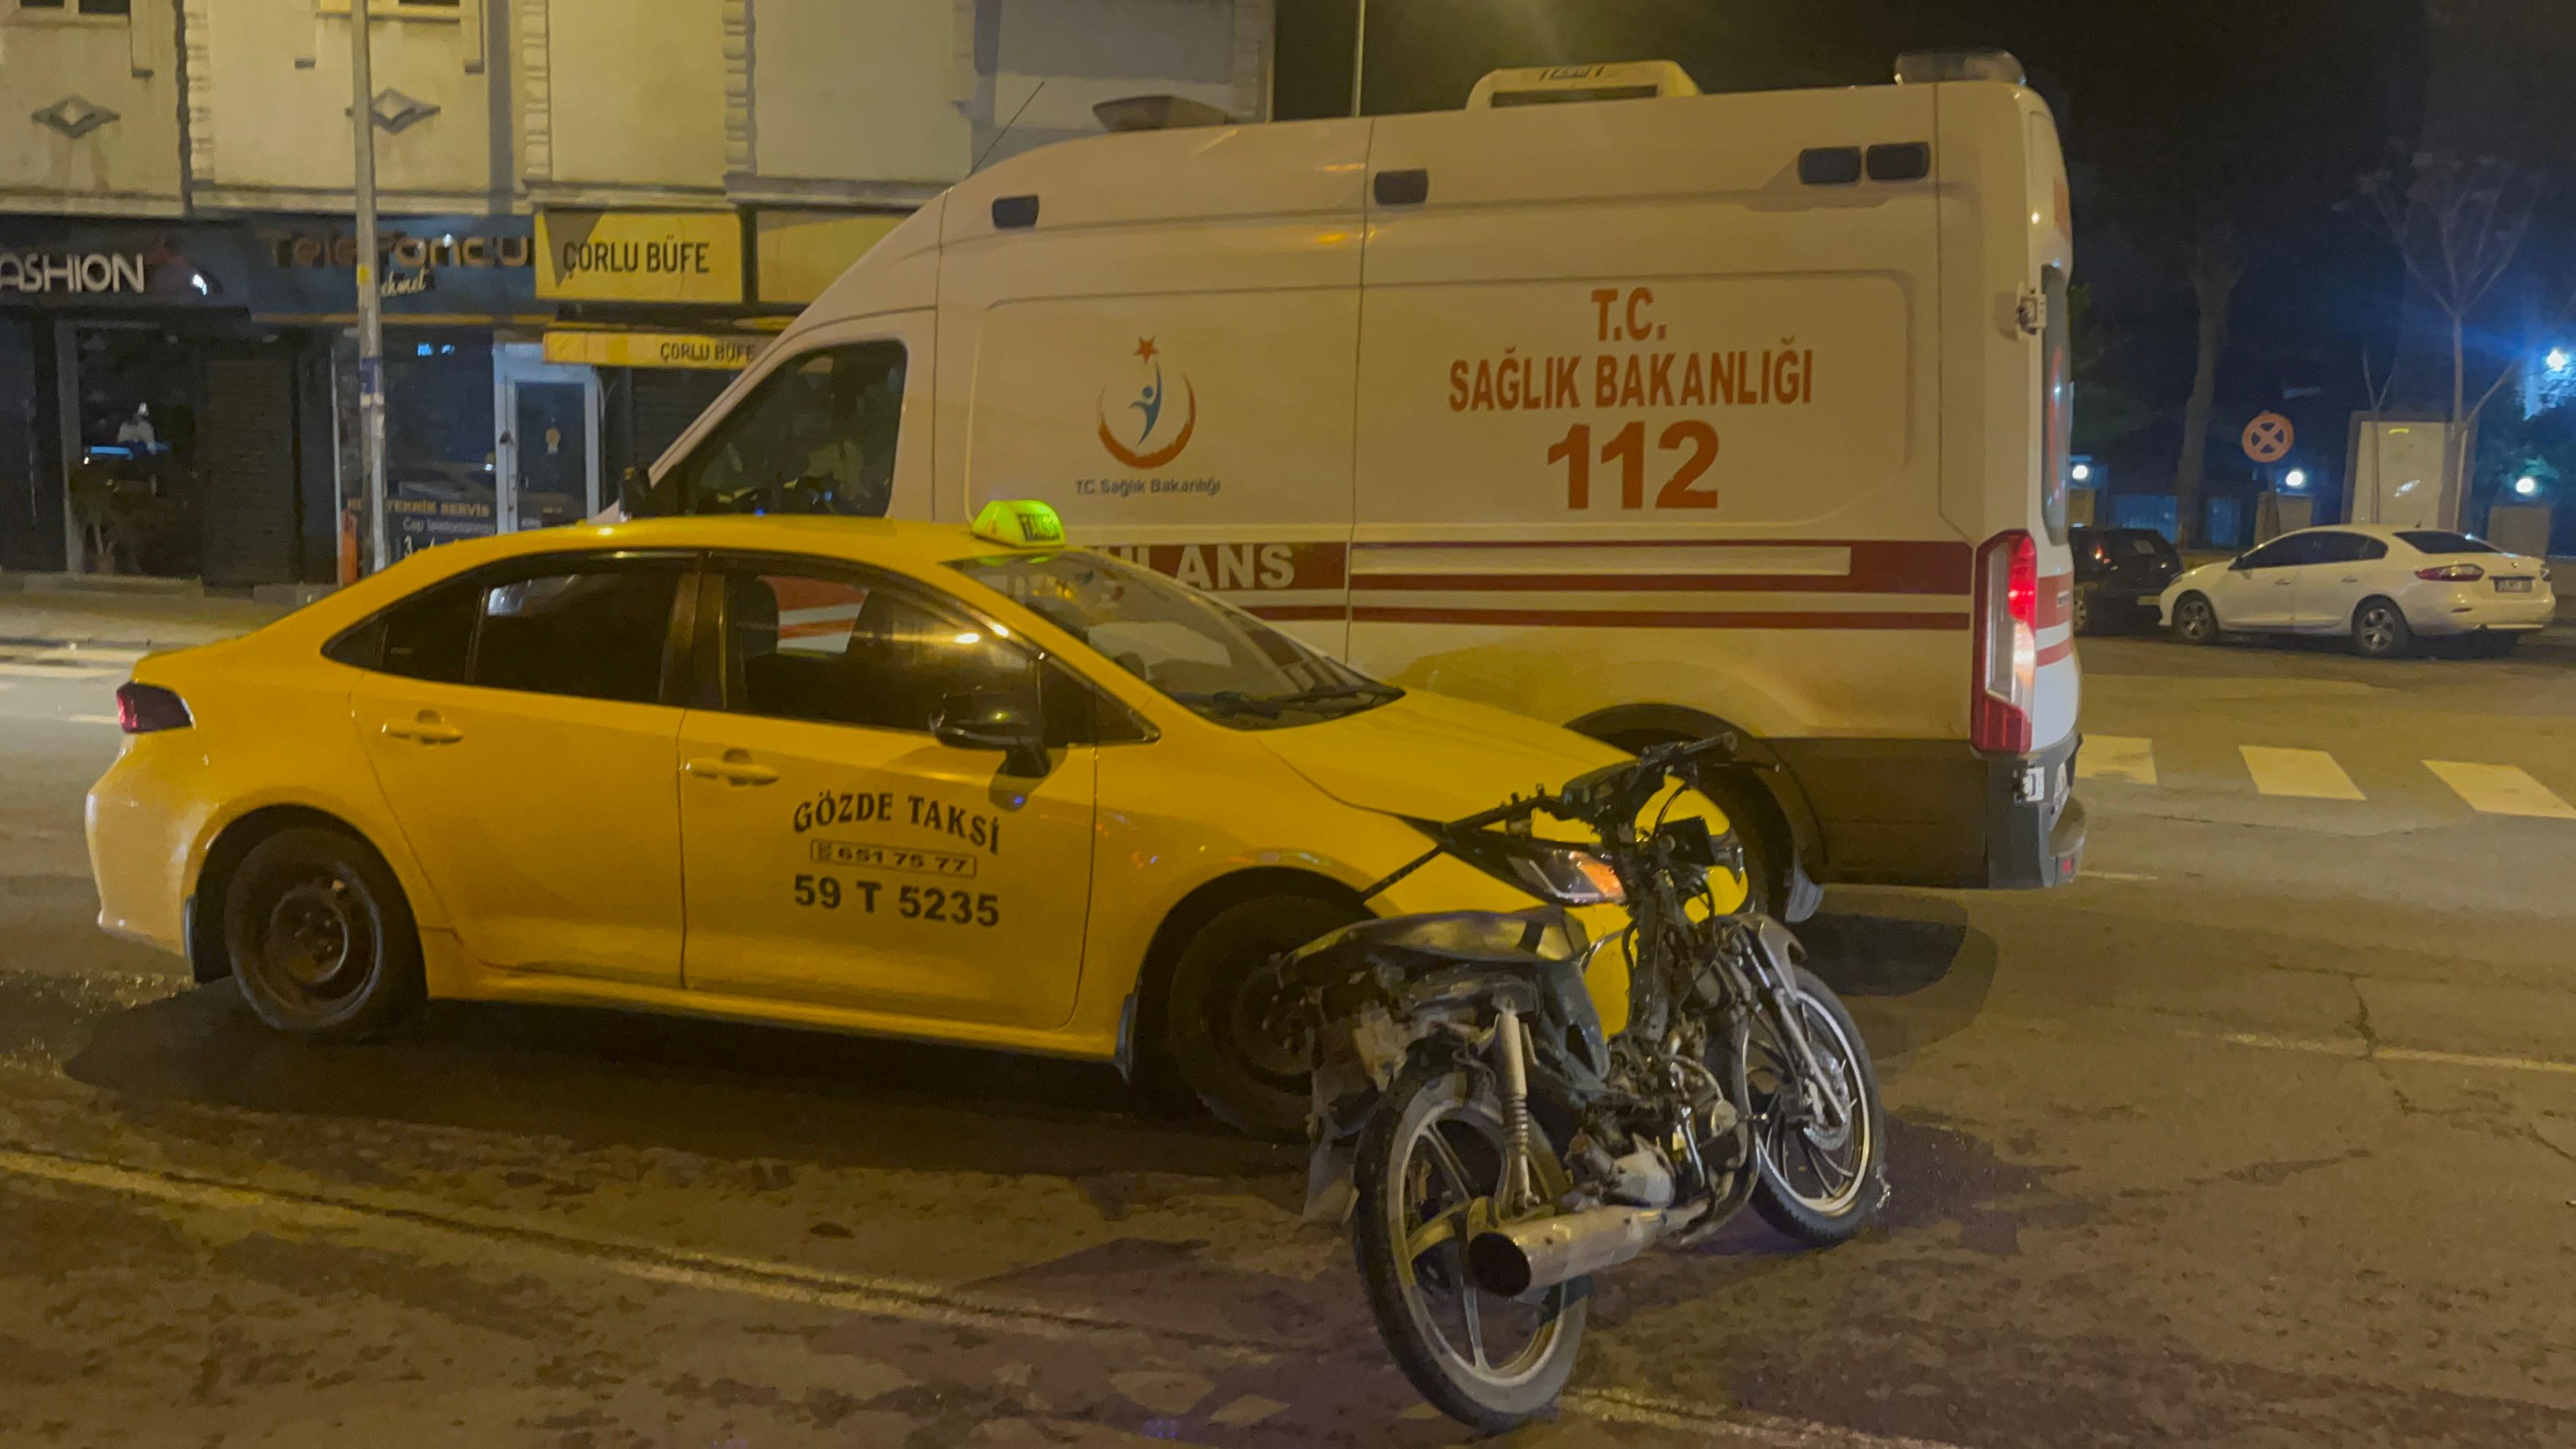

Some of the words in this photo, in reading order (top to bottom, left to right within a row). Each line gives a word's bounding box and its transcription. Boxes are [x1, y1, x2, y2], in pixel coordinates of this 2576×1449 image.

[380, 267, 430, 297] ehmet
[562, 240, 639, 280] ÇORLU
[646, 234, 710, 274] BÜFE
[1590, 287, 1667, 342] T.C.
[660, 342, 710, 362] ÇORLU
[714, 342, 756, 362] BÜFE
[1448, 345, 1581, 412] SAĞLIK
[1595, 335, 1813, 408] BAKANLIĞI
[1100, 478, 1145, 498] Sağlık
[1547, 419, 1720, 510] 112
[793, 790, 894, 834] GÖZDE
[907, 795, 1000, 855] TAKSİ
[838, 847, 883, 864] 651
[893, 853, 925, 869] 75
[935, 856, 967, 872] 77
[794, 874, 842, 910] 59
[855, 880, 883, 914] T
[899, 885, 1000, 928] 5235
